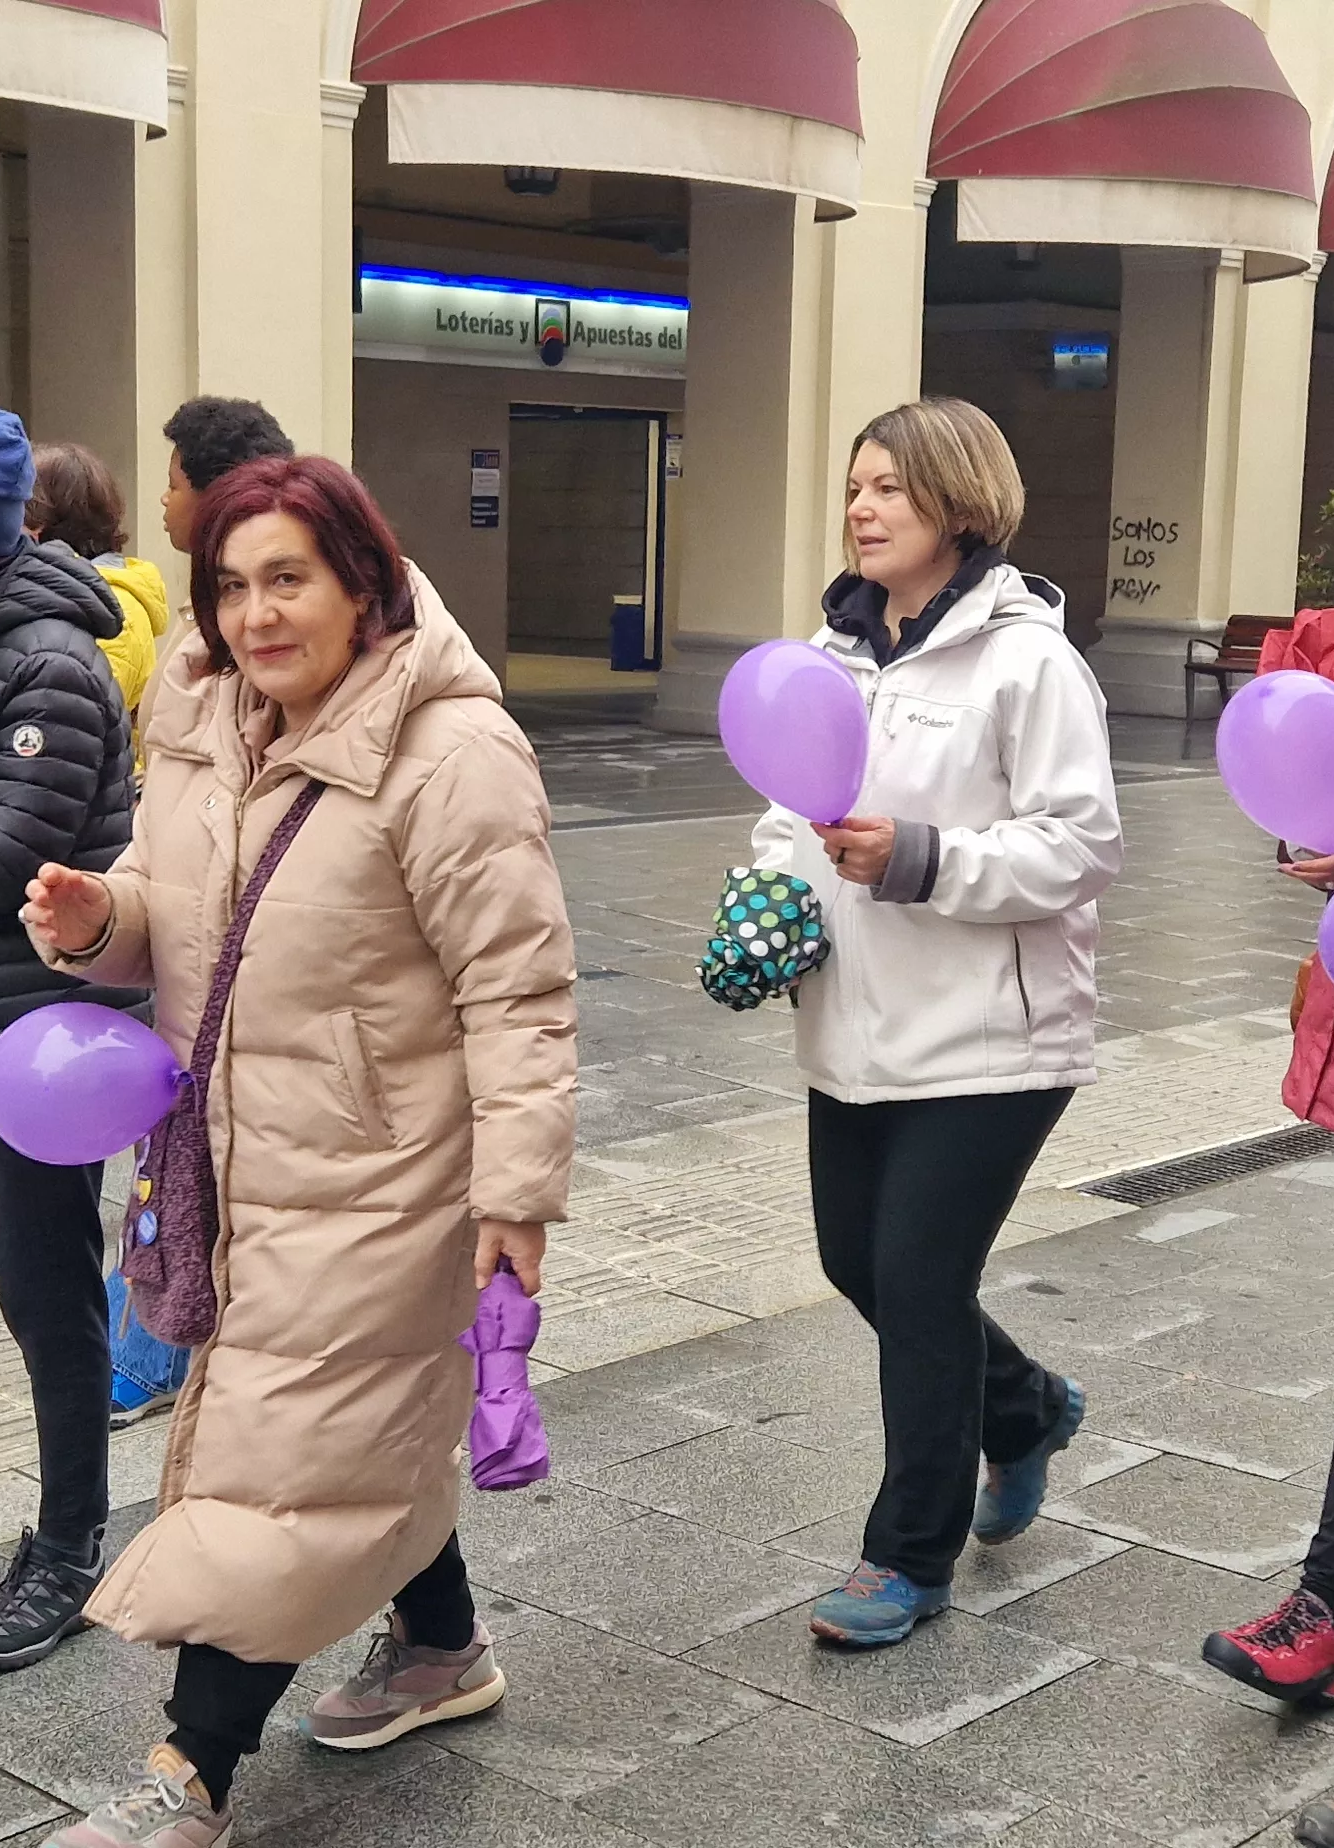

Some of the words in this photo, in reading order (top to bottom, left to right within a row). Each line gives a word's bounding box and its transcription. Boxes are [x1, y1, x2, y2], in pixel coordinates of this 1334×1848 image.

[435, 308, 514, 337] Loterías
[519, 320, 530, 345] y
[573, 320, 653, 349] Apuestas
[658, 327, 683, 350] del
[1111, 516, 1179, 544] SOMOS
[1122, 545, 1155, 568] LOS
